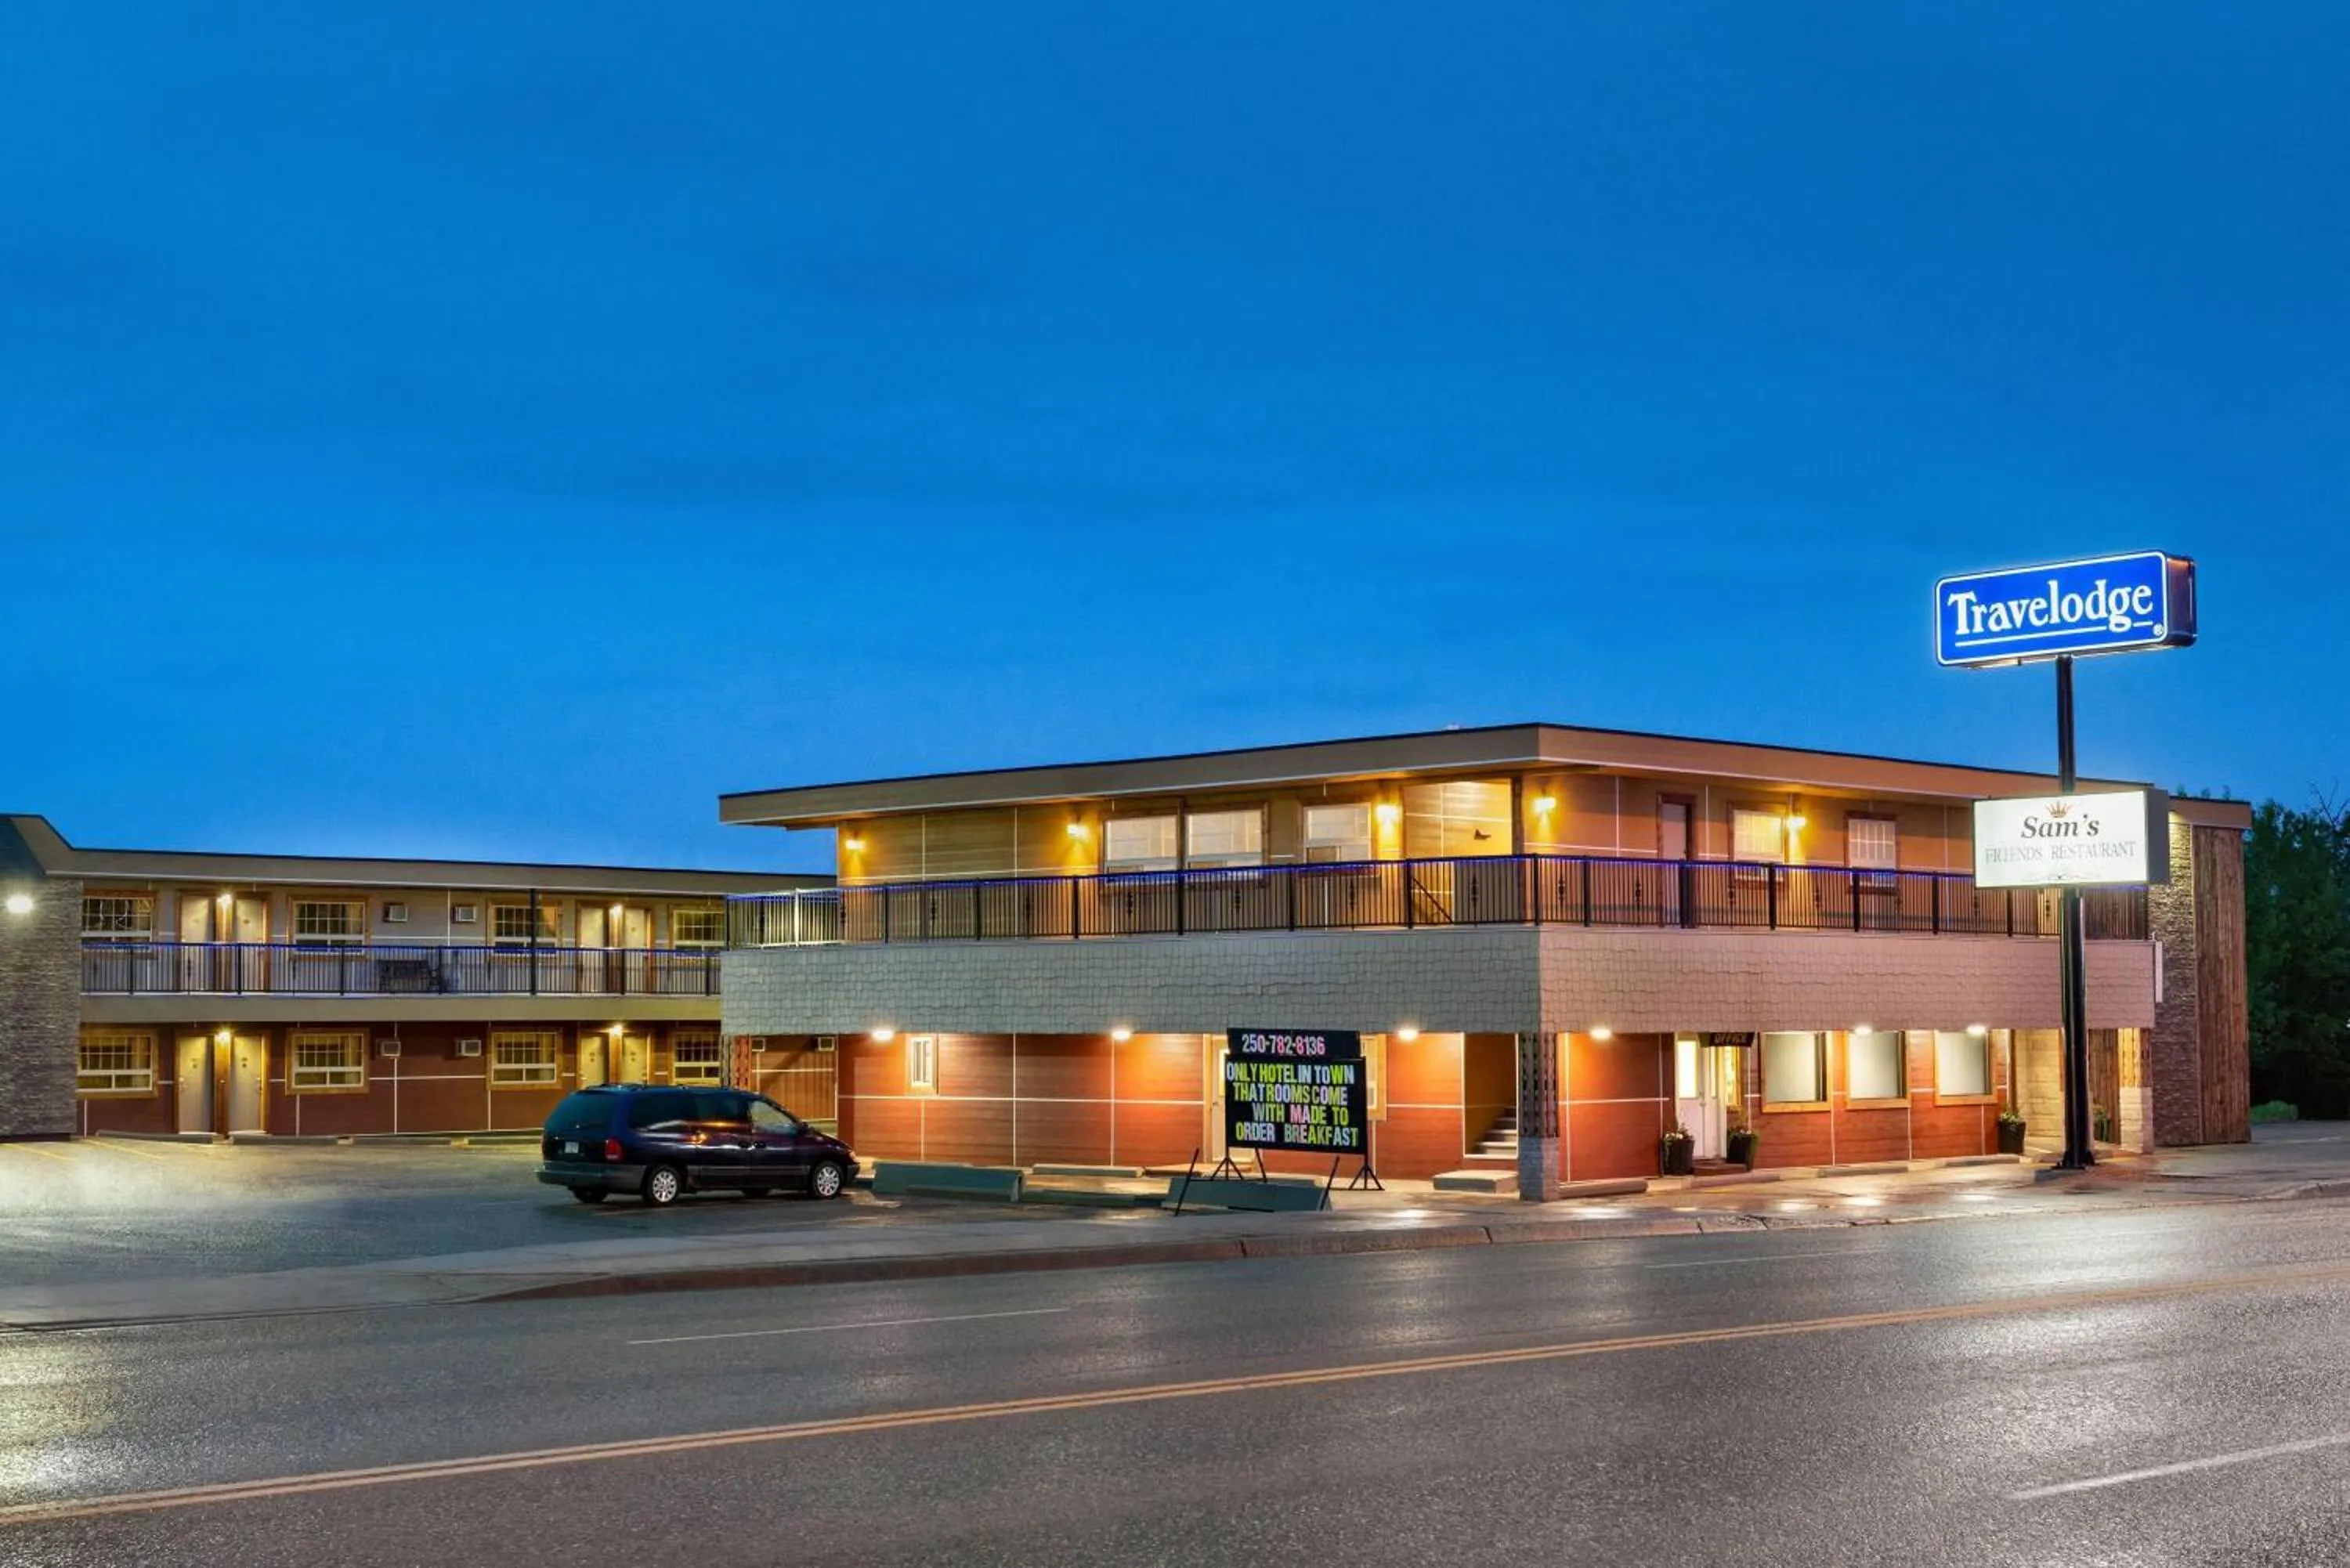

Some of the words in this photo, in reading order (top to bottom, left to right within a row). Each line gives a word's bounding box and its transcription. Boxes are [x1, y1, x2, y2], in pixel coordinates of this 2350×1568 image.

[1947, 579, 2153, 635] Travelodge
[2020, 813, 2100, 839] Sam's
[2051, 840, 2136, 861] RESTAURANT
[1242, 1034, 1325, 1055] 250-782-8136
[1227, 1062, 1258, 1082] ONLY
[1259, 1064, 1297, 1083] HOTEL
[1298, 1064, 1311, 1084] IN
[1314, 1064, 1354, 1085] TOWN
[1233, 1082, 1267, 1102] THAT
[1267, 1084, 1310, 1104] ROOMS
[1311, 1086, 1348, 1106] COME
[1252, 1102, 1285, 1122] WITH
[1289, 1104, 1327, 1125] MADE
[1332, 1106, 1349, 1125] TO
[1235, 1122, 1276, 1142] ORDER
[1284, 1125, 1358, 1147] BREAKFAST
